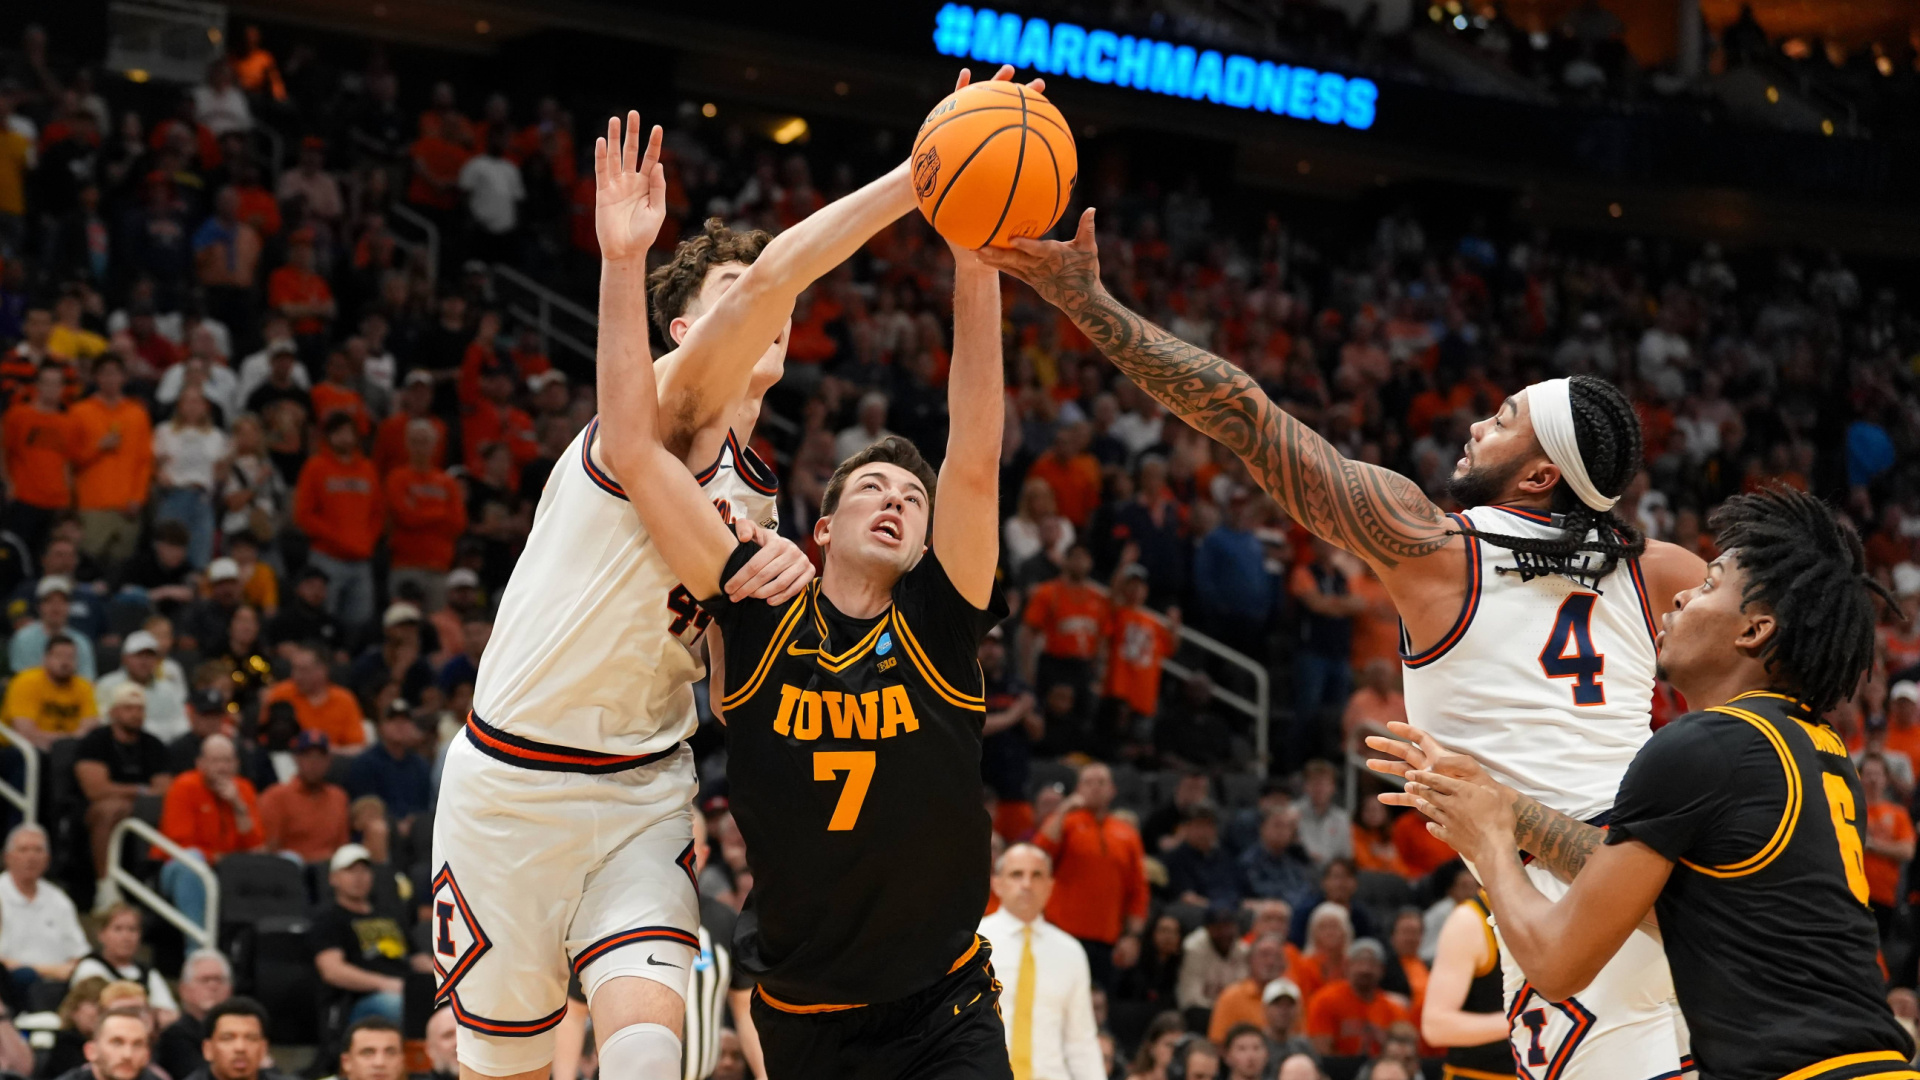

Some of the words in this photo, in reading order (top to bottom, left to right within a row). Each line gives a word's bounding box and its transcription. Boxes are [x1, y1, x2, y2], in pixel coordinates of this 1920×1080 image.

[934, 3, 1378, 129] #MARCHMADNESS
[1538, 592, 1606, 707] 4
[773, 683, 919, 741] IOWA
[813, 751, 876, 831] 7
[1822, 771, 1870, 908] 6
[437, 900, 456, 957] I
[1521, 1008, 1548, 1067] I
